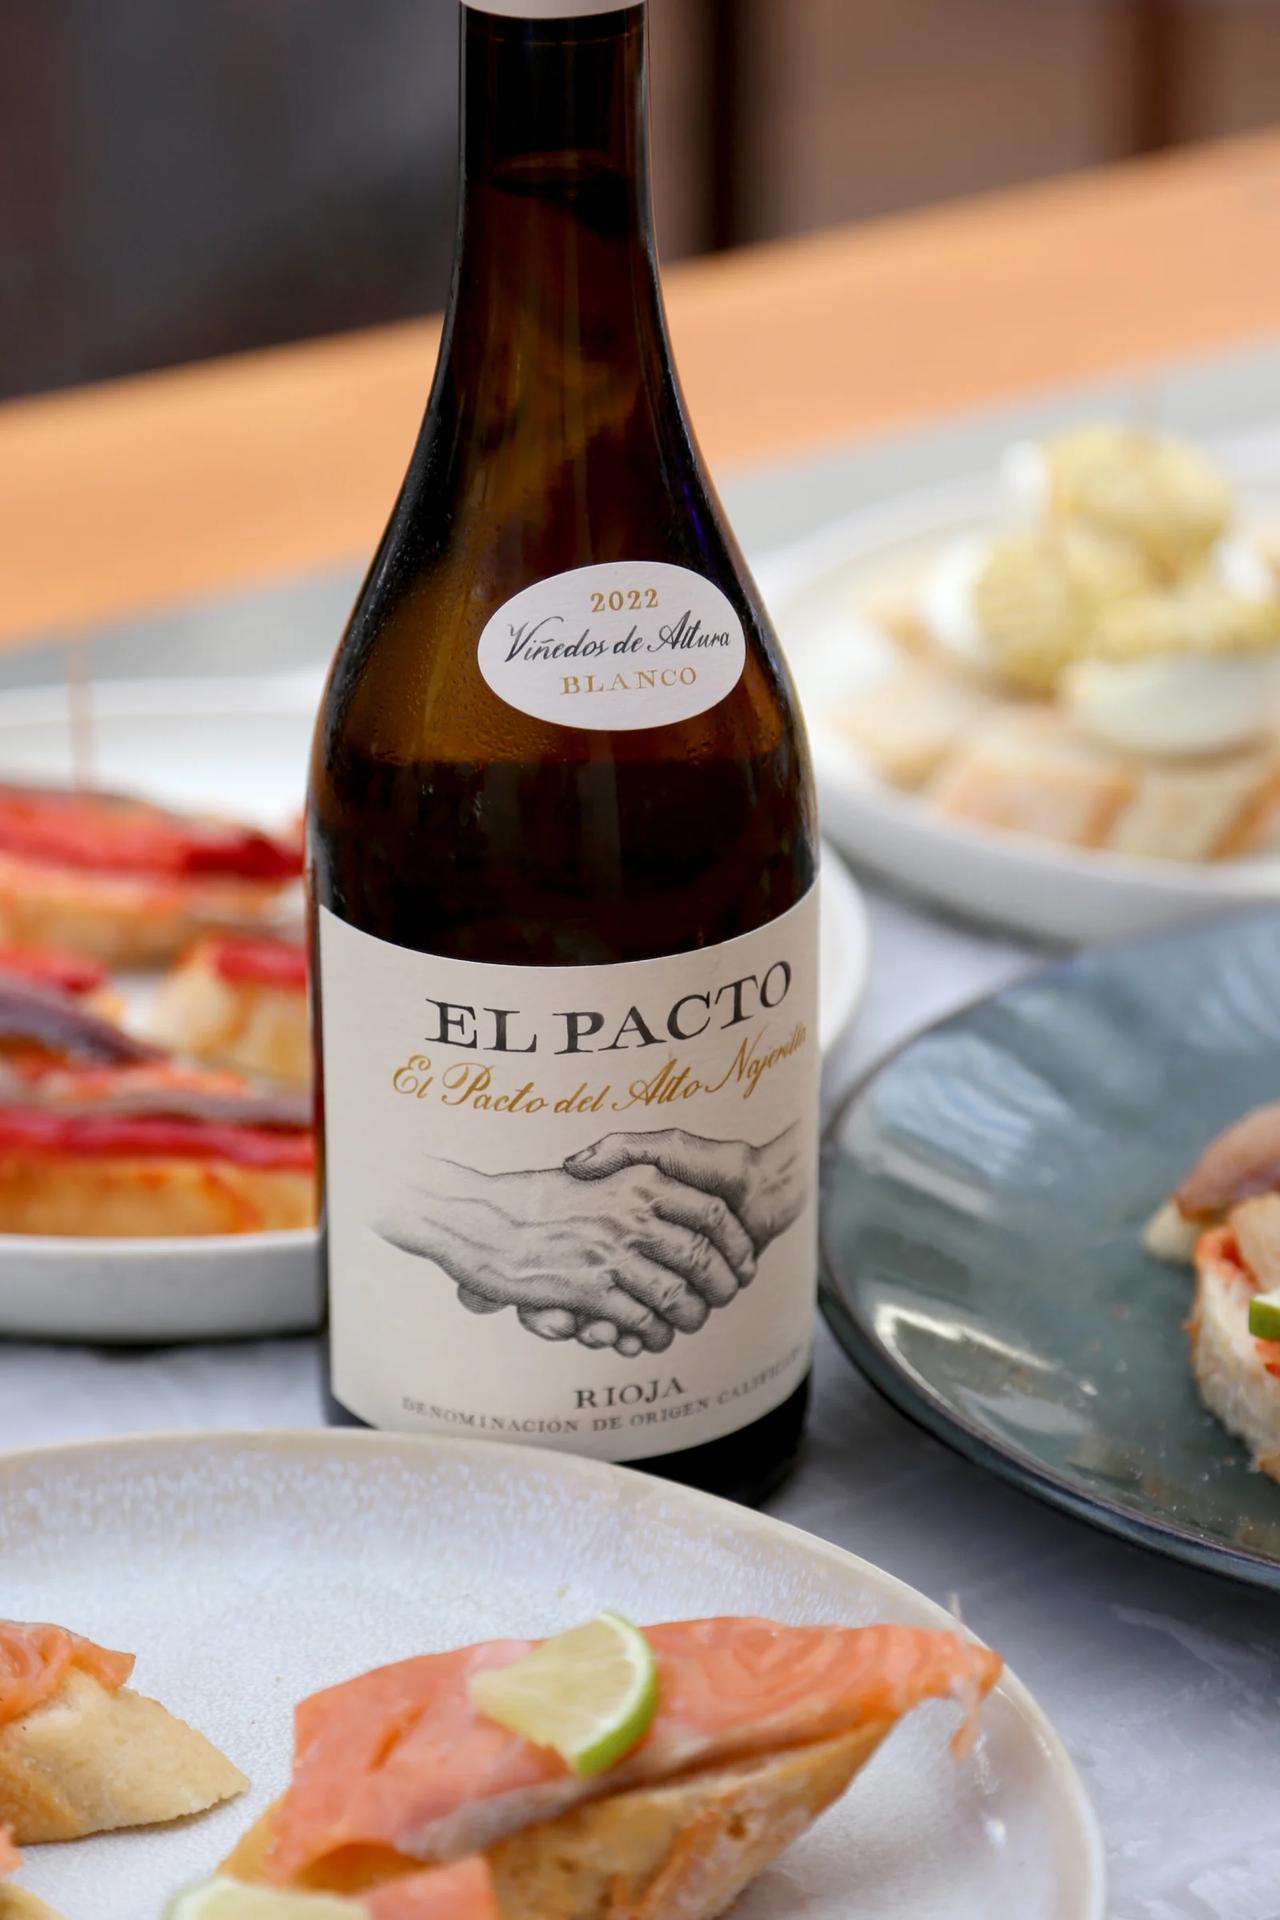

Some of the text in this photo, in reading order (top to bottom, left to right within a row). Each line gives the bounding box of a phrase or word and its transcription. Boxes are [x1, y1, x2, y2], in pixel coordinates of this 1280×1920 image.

[590, 588, 659, 612] 2022
[505, 609, 731, 663] Viñedos de Altura
[559, 667, 697, 695] BLANCO
[425, 960, 792, 1055] EL PACTO
[393, 1055, 433, 1098] El
[441, 1062, 549, 1114] Pacto
[553, 1082, 610, 1113] del
[612, 1056, 703, 1110] Alto
[574, 1376, 686, 1409] RIOJA
[592, 1416, 623, 1432] DE
[629, 1396, 711, 1427] ORIGEN
